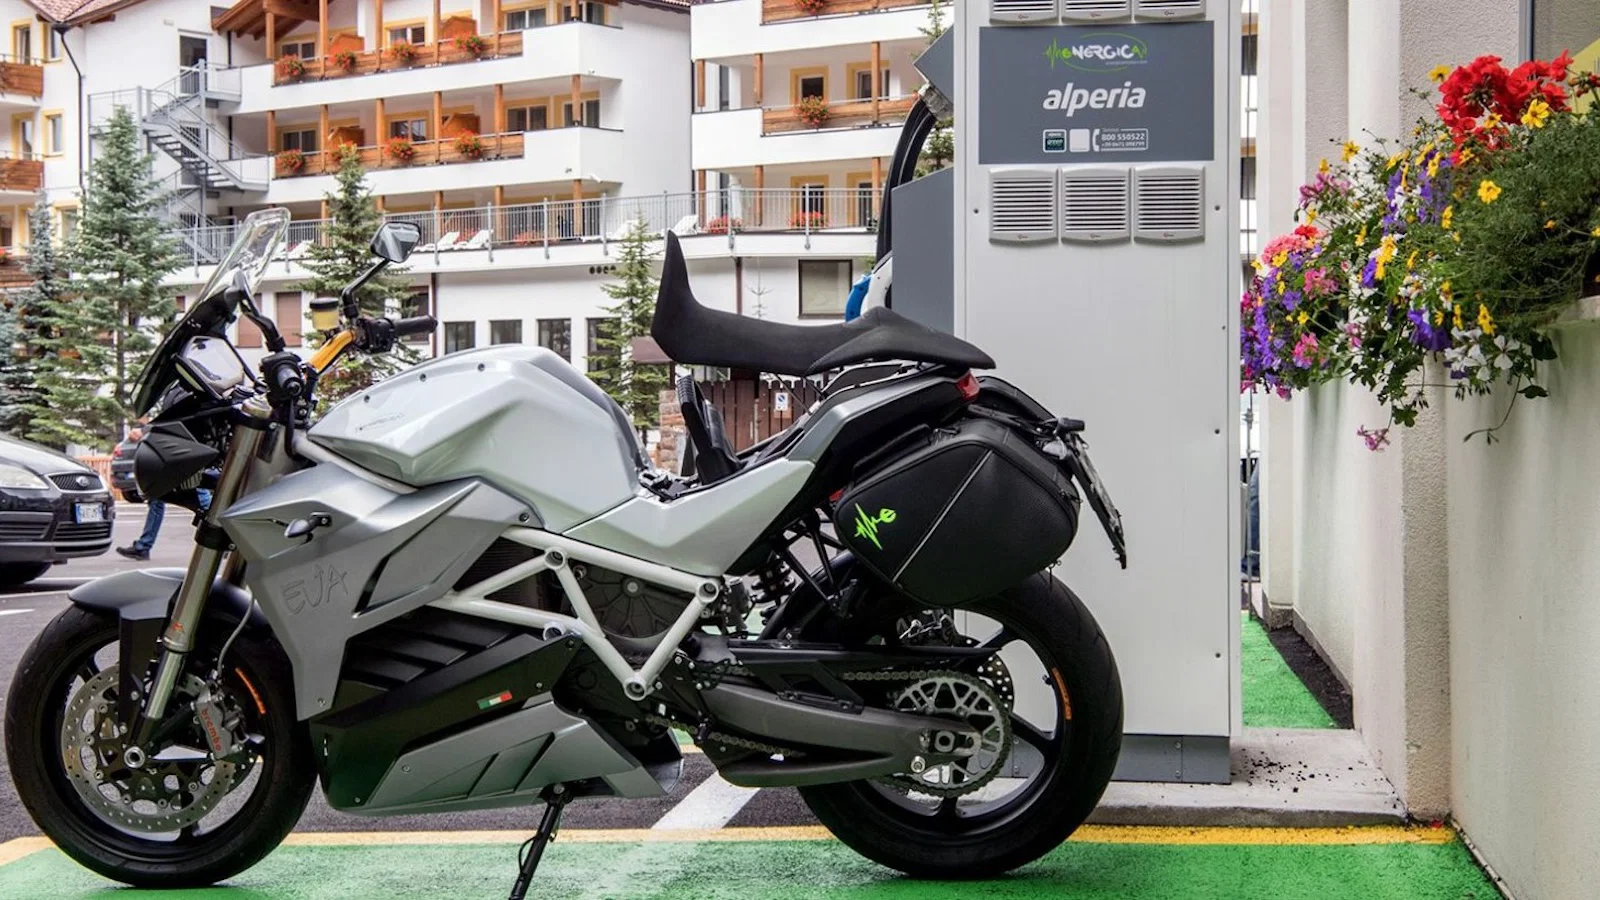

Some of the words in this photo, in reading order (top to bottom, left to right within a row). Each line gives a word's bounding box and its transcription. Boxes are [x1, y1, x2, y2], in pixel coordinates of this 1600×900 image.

[1043, 81, 1146, 117] alperia
[1101, 133, 1116, 141] 800
[201, 704, 222, 752] brembo
